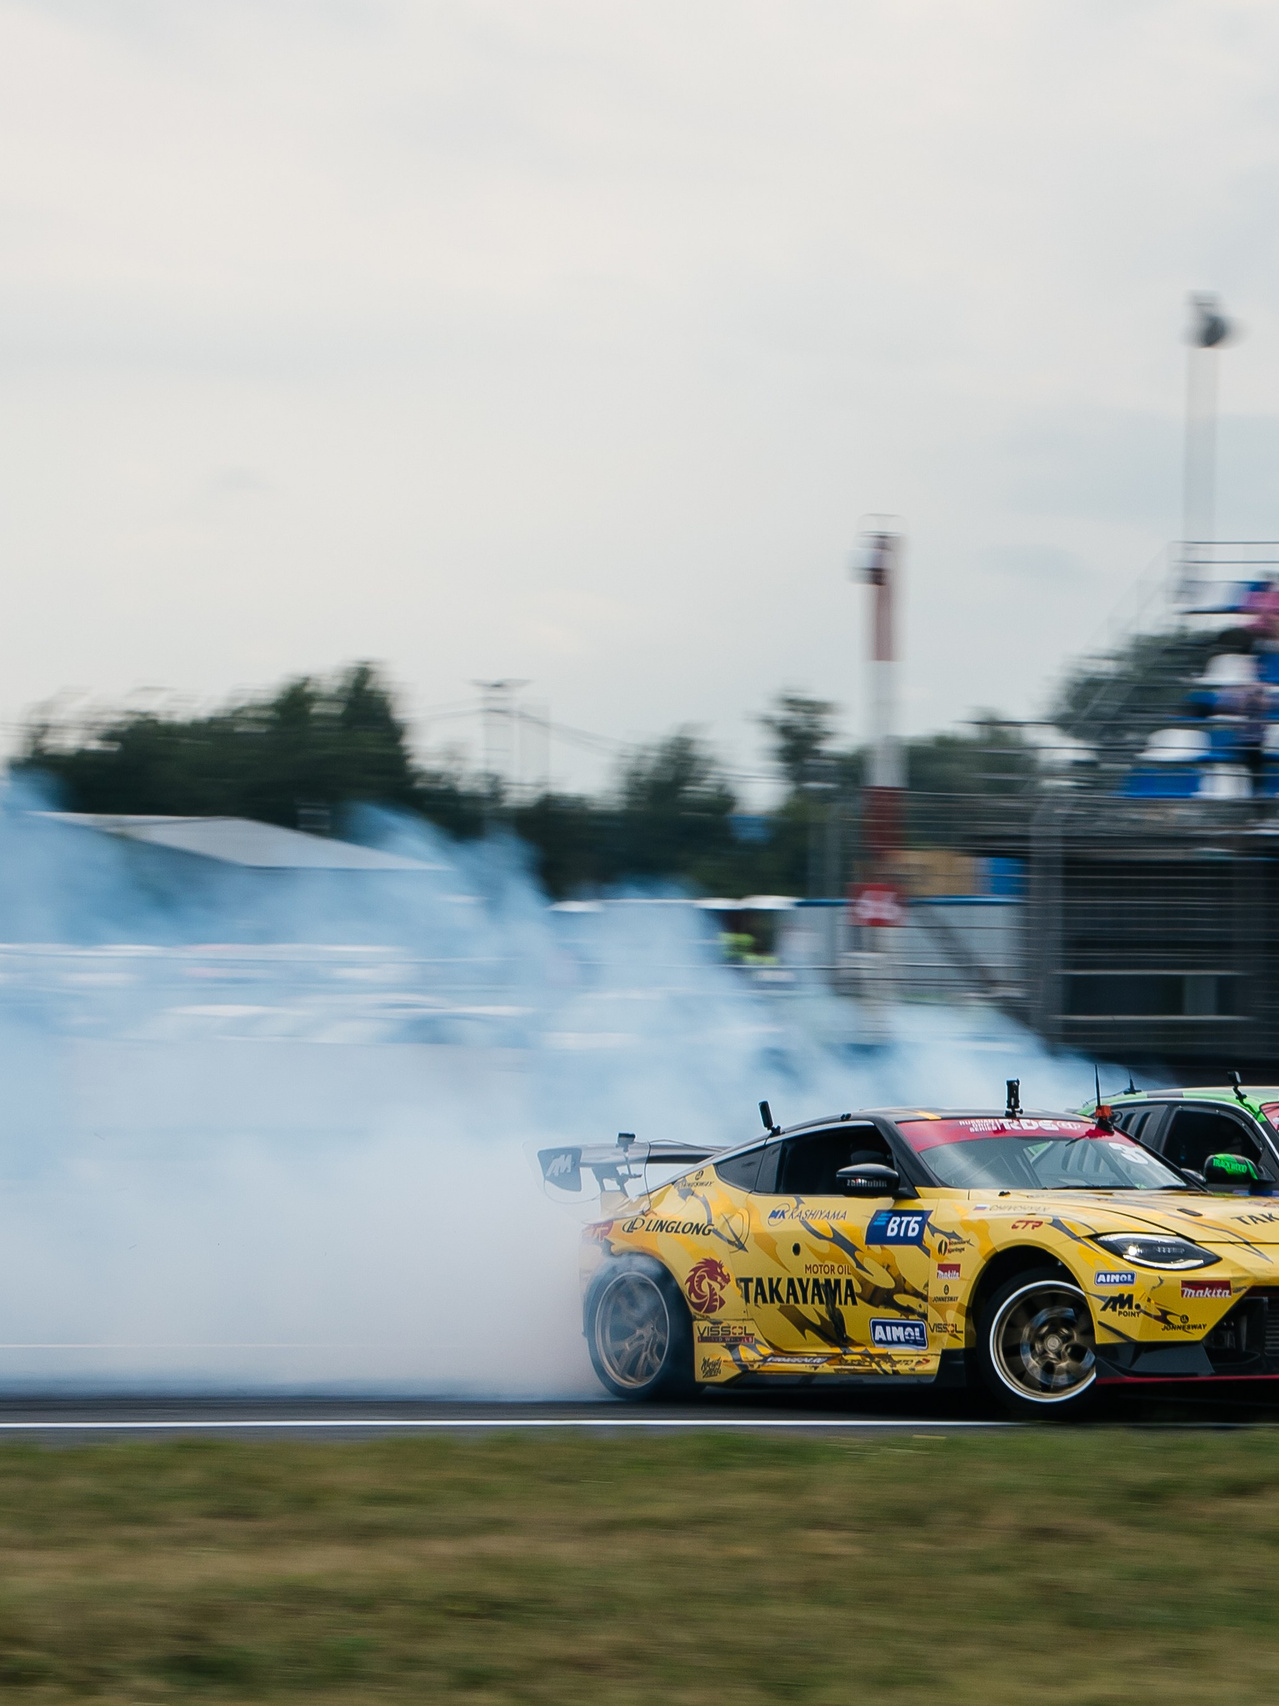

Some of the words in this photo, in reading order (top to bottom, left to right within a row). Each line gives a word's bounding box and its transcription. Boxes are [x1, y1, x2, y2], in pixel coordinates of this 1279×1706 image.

[999, 1118, 1059, 1131] RDS
[788, 1208, 847, 1220] KASHIYAMA
[645, 1219, 714, 1236] LINGLONG
[805, 1264, 835, 1274] MOTOR
[838, 1264, 851, 1275] OIL
[738, 1276, 858, 1306] TAKAYAMA
[1117, 1310, 1141, 1318] POINT
[697, 1325, 755, 1337] VISSOL
[928, 1322, 964, 1334] VISSOL
[1161, 1323, 1207, 1332] JONNESWAY
[874, 1324, 924, 1344] AIMOL
